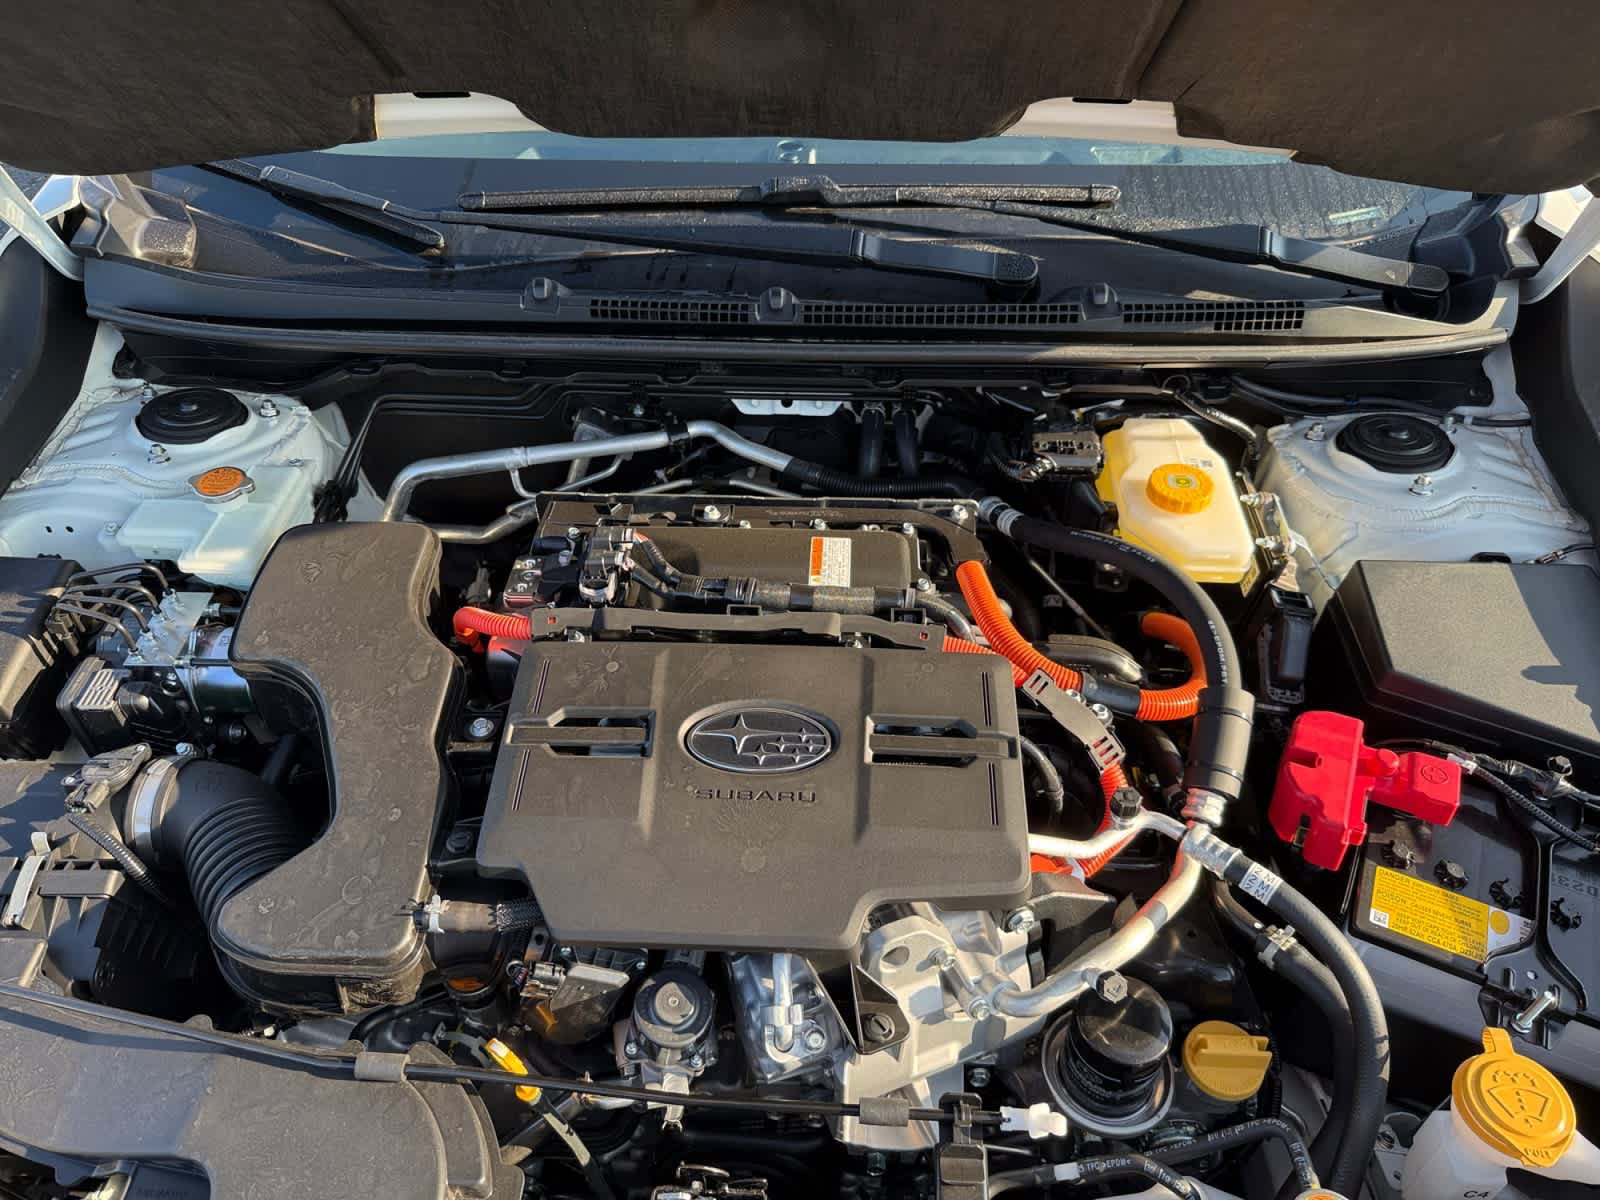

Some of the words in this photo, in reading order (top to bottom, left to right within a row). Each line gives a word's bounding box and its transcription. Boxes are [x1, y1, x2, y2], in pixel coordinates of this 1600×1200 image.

[695, 788, 816, 803] SUBARU
[1379, 868, 1411, 884] DANGER
[1376, 887, 1407, 905] POISON
[1463, 1190, 1490, 1199] C4
